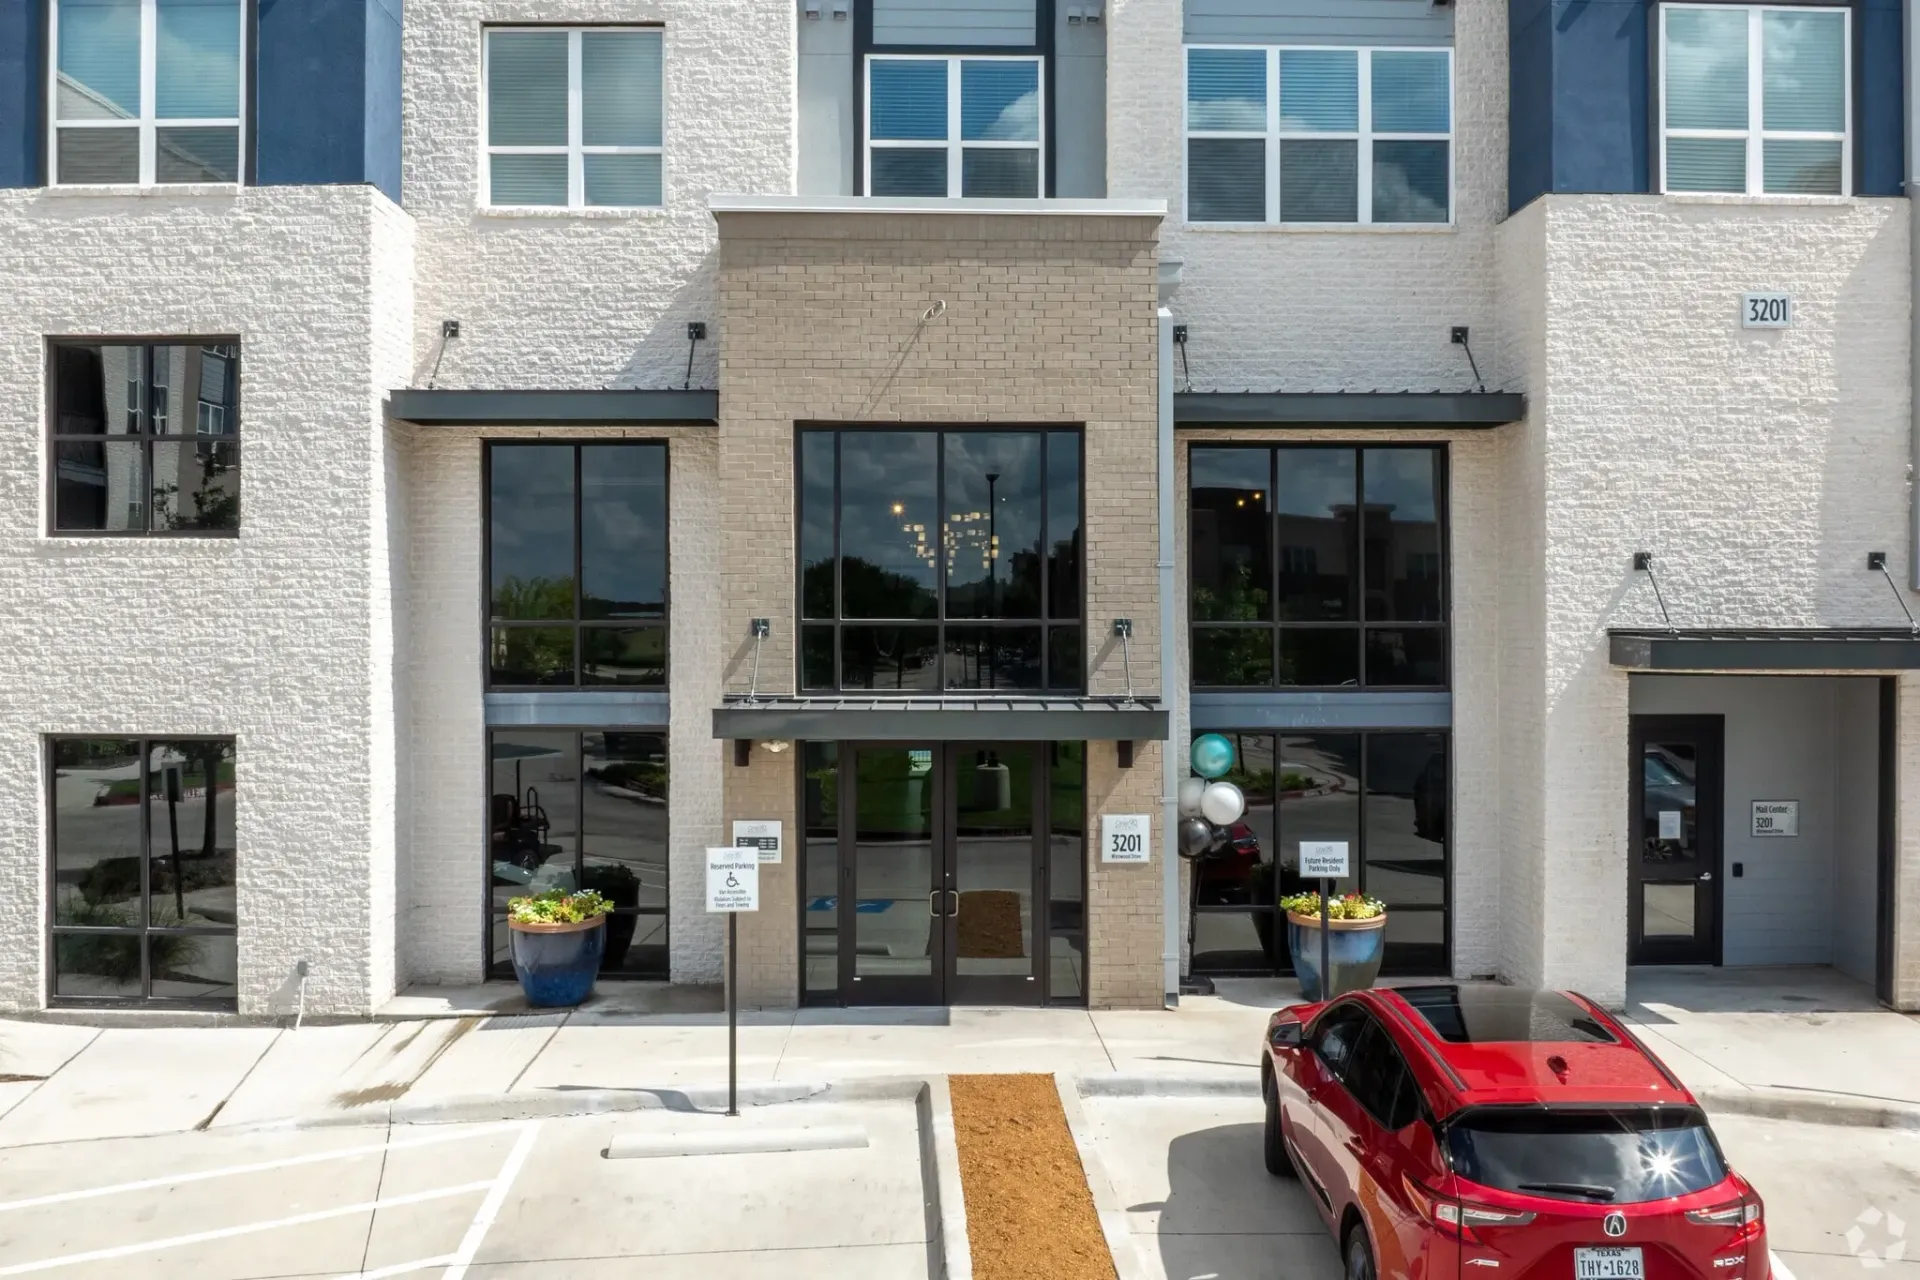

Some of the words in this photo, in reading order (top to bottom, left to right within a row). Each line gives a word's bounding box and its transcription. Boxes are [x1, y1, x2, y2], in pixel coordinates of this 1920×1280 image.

[1749, 298, 1787, 322] 3201
[1755, 805, 1768, 814] Mail
[1769, 805, 1788, 814] Center
[1755, 817, 1773, 828] 3201
[1111, 834, 1141, 852] 3201
[735, 862, 755, 870] Parking
[1308, 865, 1328, 873] Parking
[1329, 864, 1341, 873] Only
[1713, 1255, 1745, 1268] RDX
